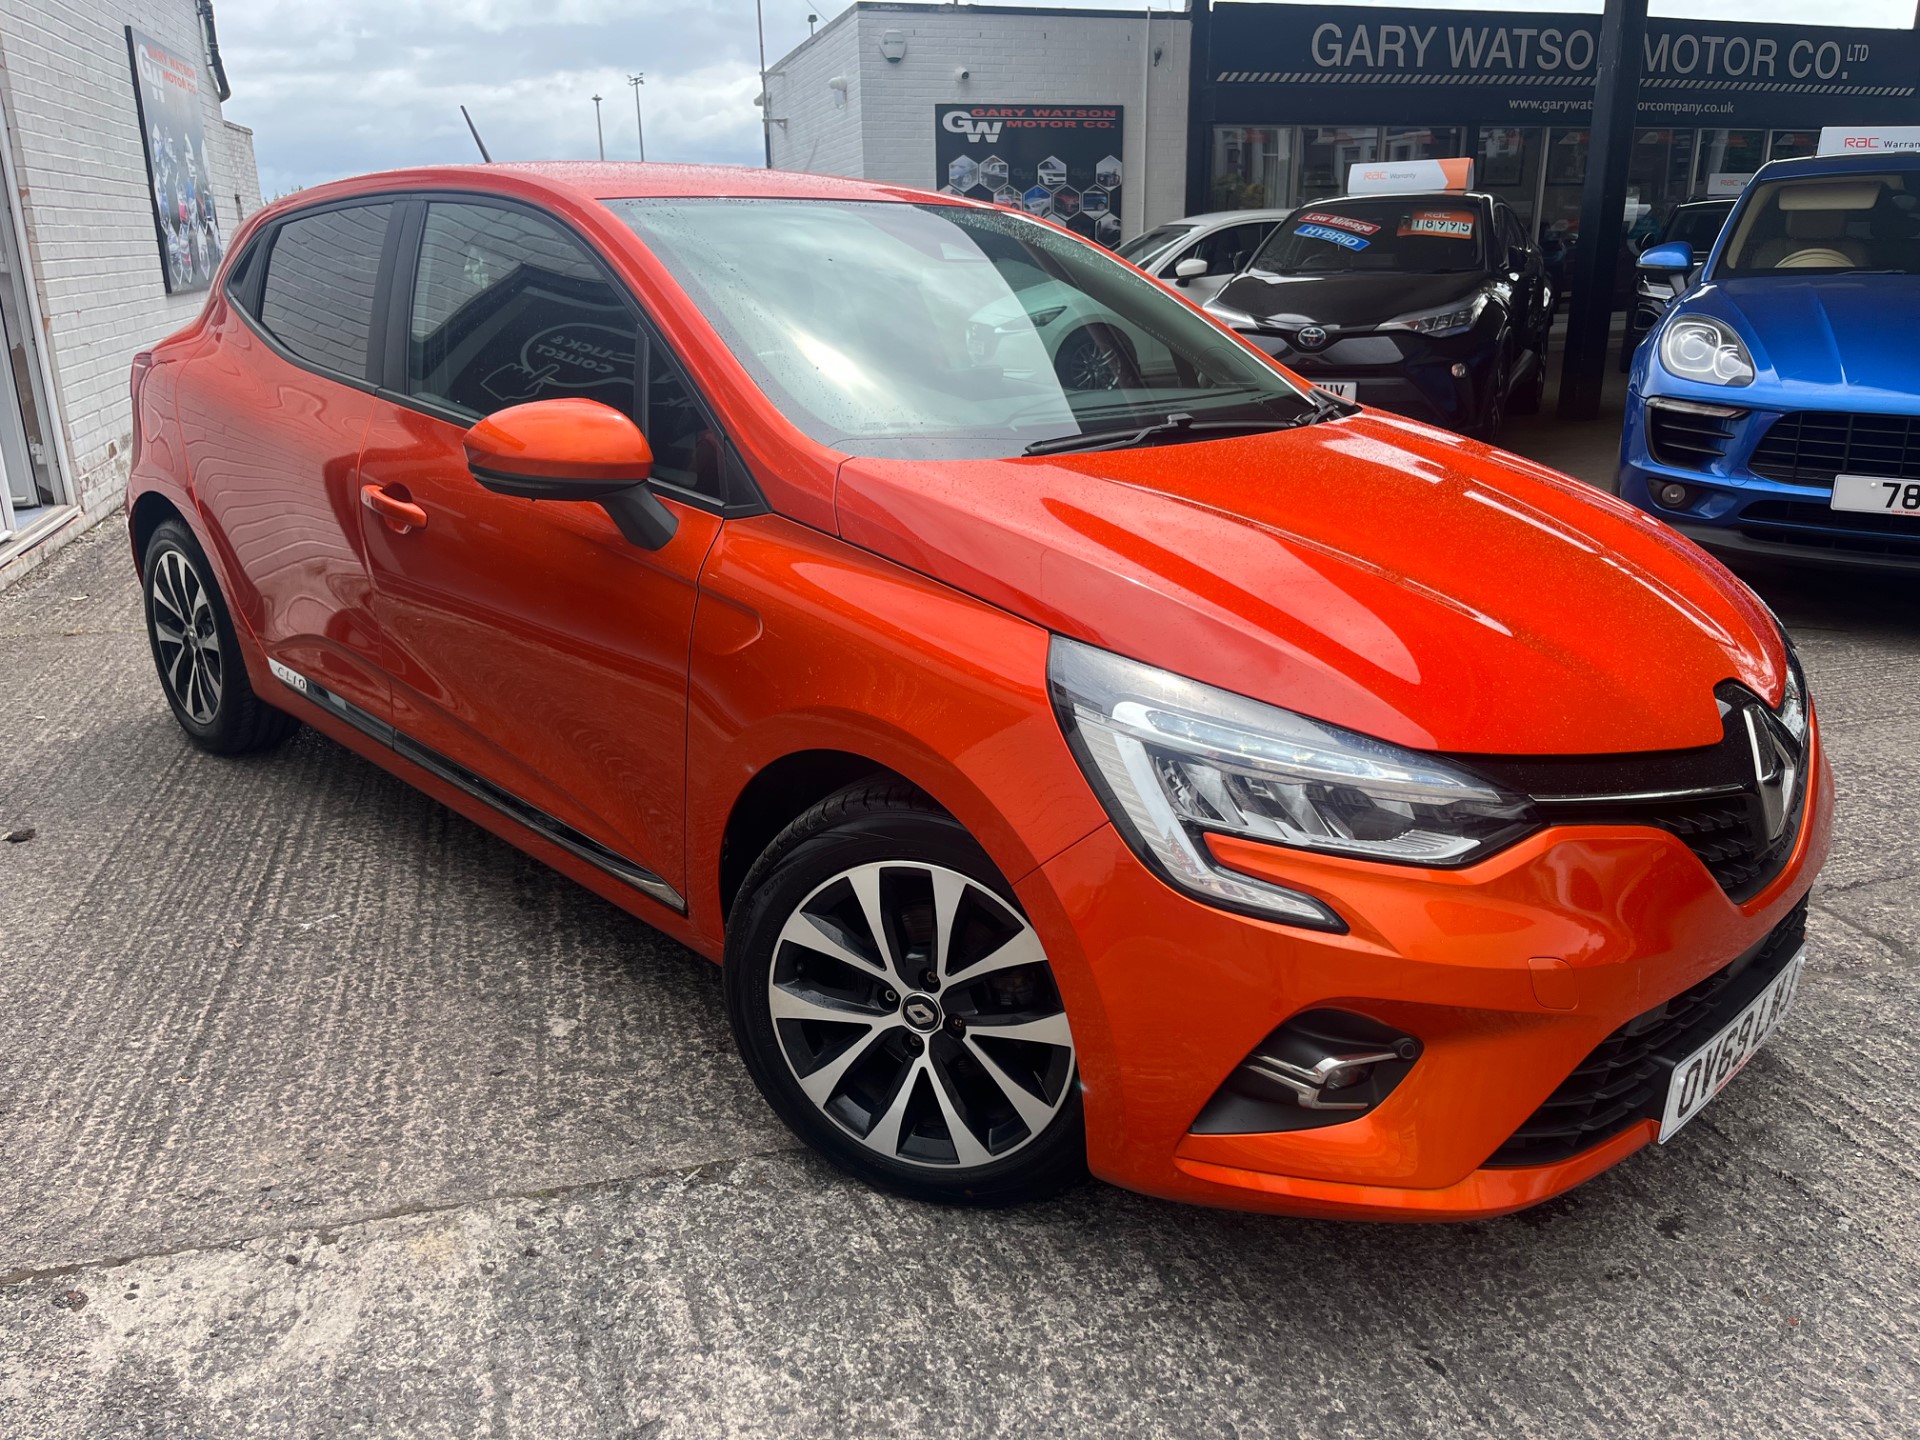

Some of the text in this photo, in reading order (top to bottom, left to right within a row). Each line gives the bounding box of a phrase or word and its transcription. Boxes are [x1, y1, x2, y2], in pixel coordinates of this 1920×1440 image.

[1311, 23, 1869, 80] GARY WATSO MOTOR CO. LTD
[971, 108, 1116, 118] GARY WATSON
[1508, 99, 1734, 115] www.garywatorcompany.co.uk
[942, 111, 1003, 143] GW
[1006, 120, 1115, 129] MOTOR CO.
[1390, 172, 1416, 180] Warranty
[1304, 213, 1374, 232] Low Mileage
[1303, 225, 1359, 246] HYBRID
[278, 667, 306, 690] CLIO
[1677, 1010, 1755, 1119] OV69
